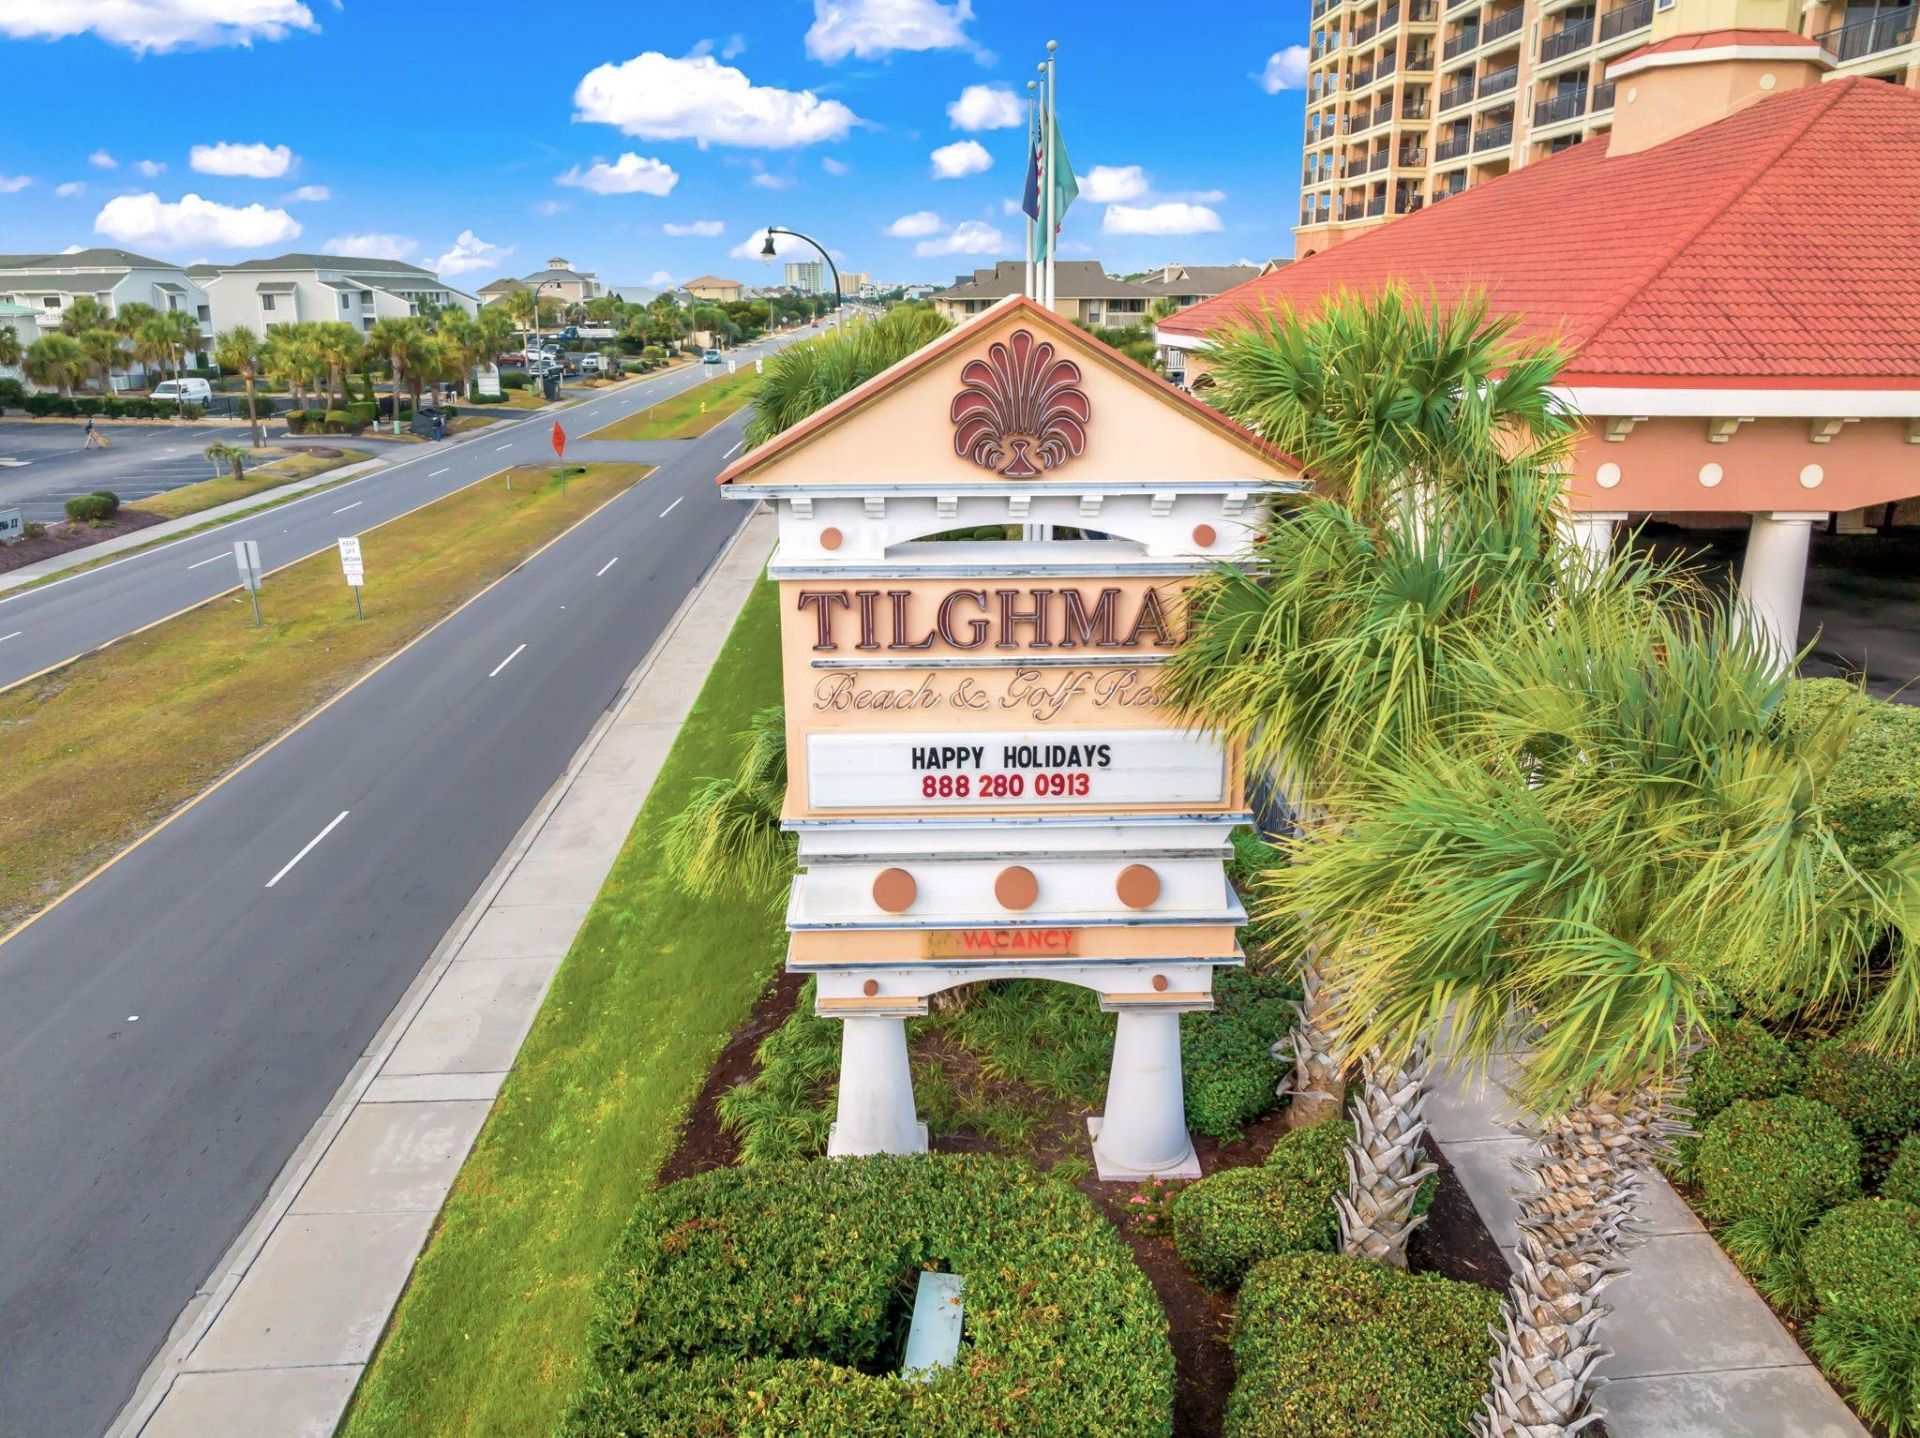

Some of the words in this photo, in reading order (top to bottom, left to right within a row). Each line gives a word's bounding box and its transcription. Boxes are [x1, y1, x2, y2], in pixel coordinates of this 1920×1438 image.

[797, 586, 1208, 651] TILGHMA
[813, 672, 943, 713] Beach
[950, 678, 990, 711] &
[999, 667, 1094, 722] Golf
[1093, 668, 1184, 710] Res
[911, 746, 985, 771] HAPPY
[1003, 744, 1112, 769] HOLIDAYS
[921, 774, 970, 799] 888
[978, 773, 1024, 798] 280
[1034, 772, 1091, 797] 0913
[962, 930, 1074, 949] VACANCY
